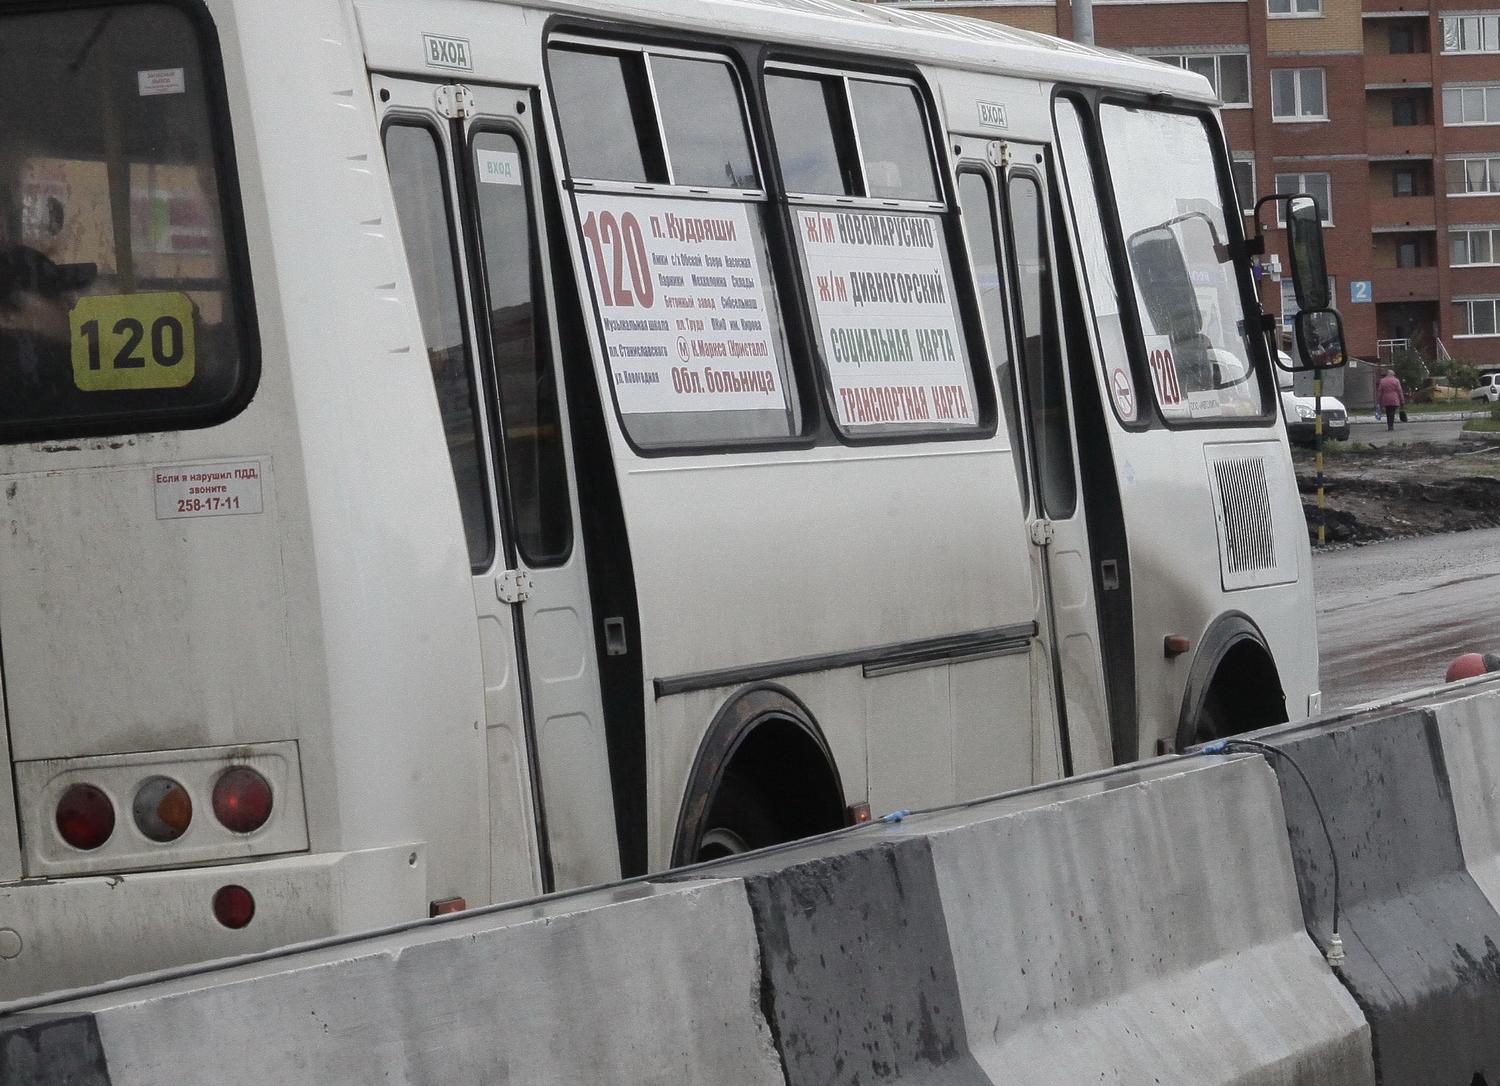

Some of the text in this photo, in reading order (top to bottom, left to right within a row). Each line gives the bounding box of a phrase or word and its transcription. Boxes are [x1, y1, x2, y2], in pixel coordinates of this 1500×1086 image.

[429, 39, 467, 66] ВХОД
[981, 104, 1005, 126] ВХОД
[665, 213, 737, 242] Кудряши
[836, 214, 934, 248] НОВОМАРУСИНО
[583, 211, 654, 309] 120
[850, 268, 946, 307] ДИВНОГОРСКИЙ
[1356, 282, 1367, 298] 2
[81, 316, 183, 370] 120
[830, 327, 955, 368] СОЦИАЛЬНАЯ КАРТА
[671, 367, 705, 394] Обл.
[705, 367, 775, 395] больница
[1150, 349, 1180, 405] 120
[839, 386, 968, 422] ТРАНСПОРТНАЯ КАРТА
[156, 474, 179, 484] Если
[190, 472, 232, 482] нарушил
[235, 468, 259, 480] ПДД,
[189, 485, 227, 495] звоните
[177, 496, 240, 513] 258-17-11
